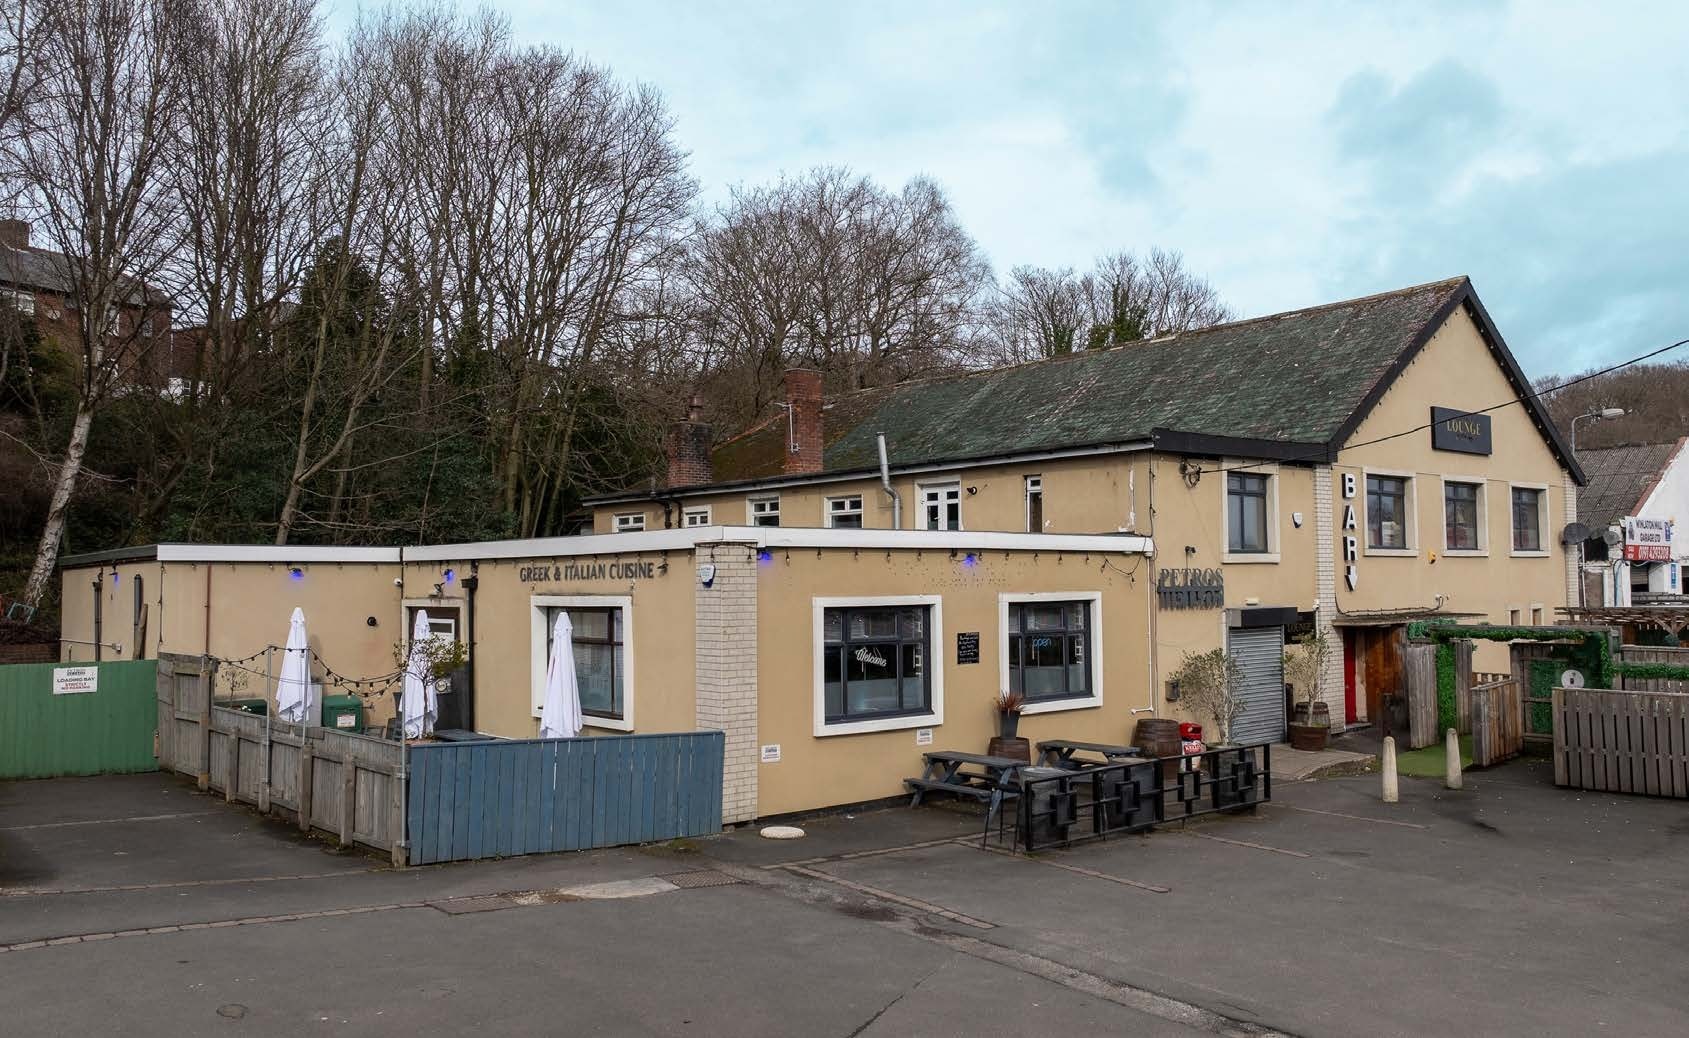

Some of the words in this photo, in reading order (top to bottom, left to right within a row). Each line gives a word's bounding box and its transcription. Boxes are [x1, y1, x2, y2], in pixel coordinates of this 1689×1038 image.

[1446, 419, 1481, 436] LOUNGE
[1341, 473, 1358, 562] BAR
[520, 566, 550, 582] GREEK
[554, 567, 561, 580] &
[564, 563, 606, 581] ITALIAN
[609, 562, 655, 579] CUISINE
[1159, 567, 1224, 590] PETROS
[855, 646, 887, 667] Welcome
